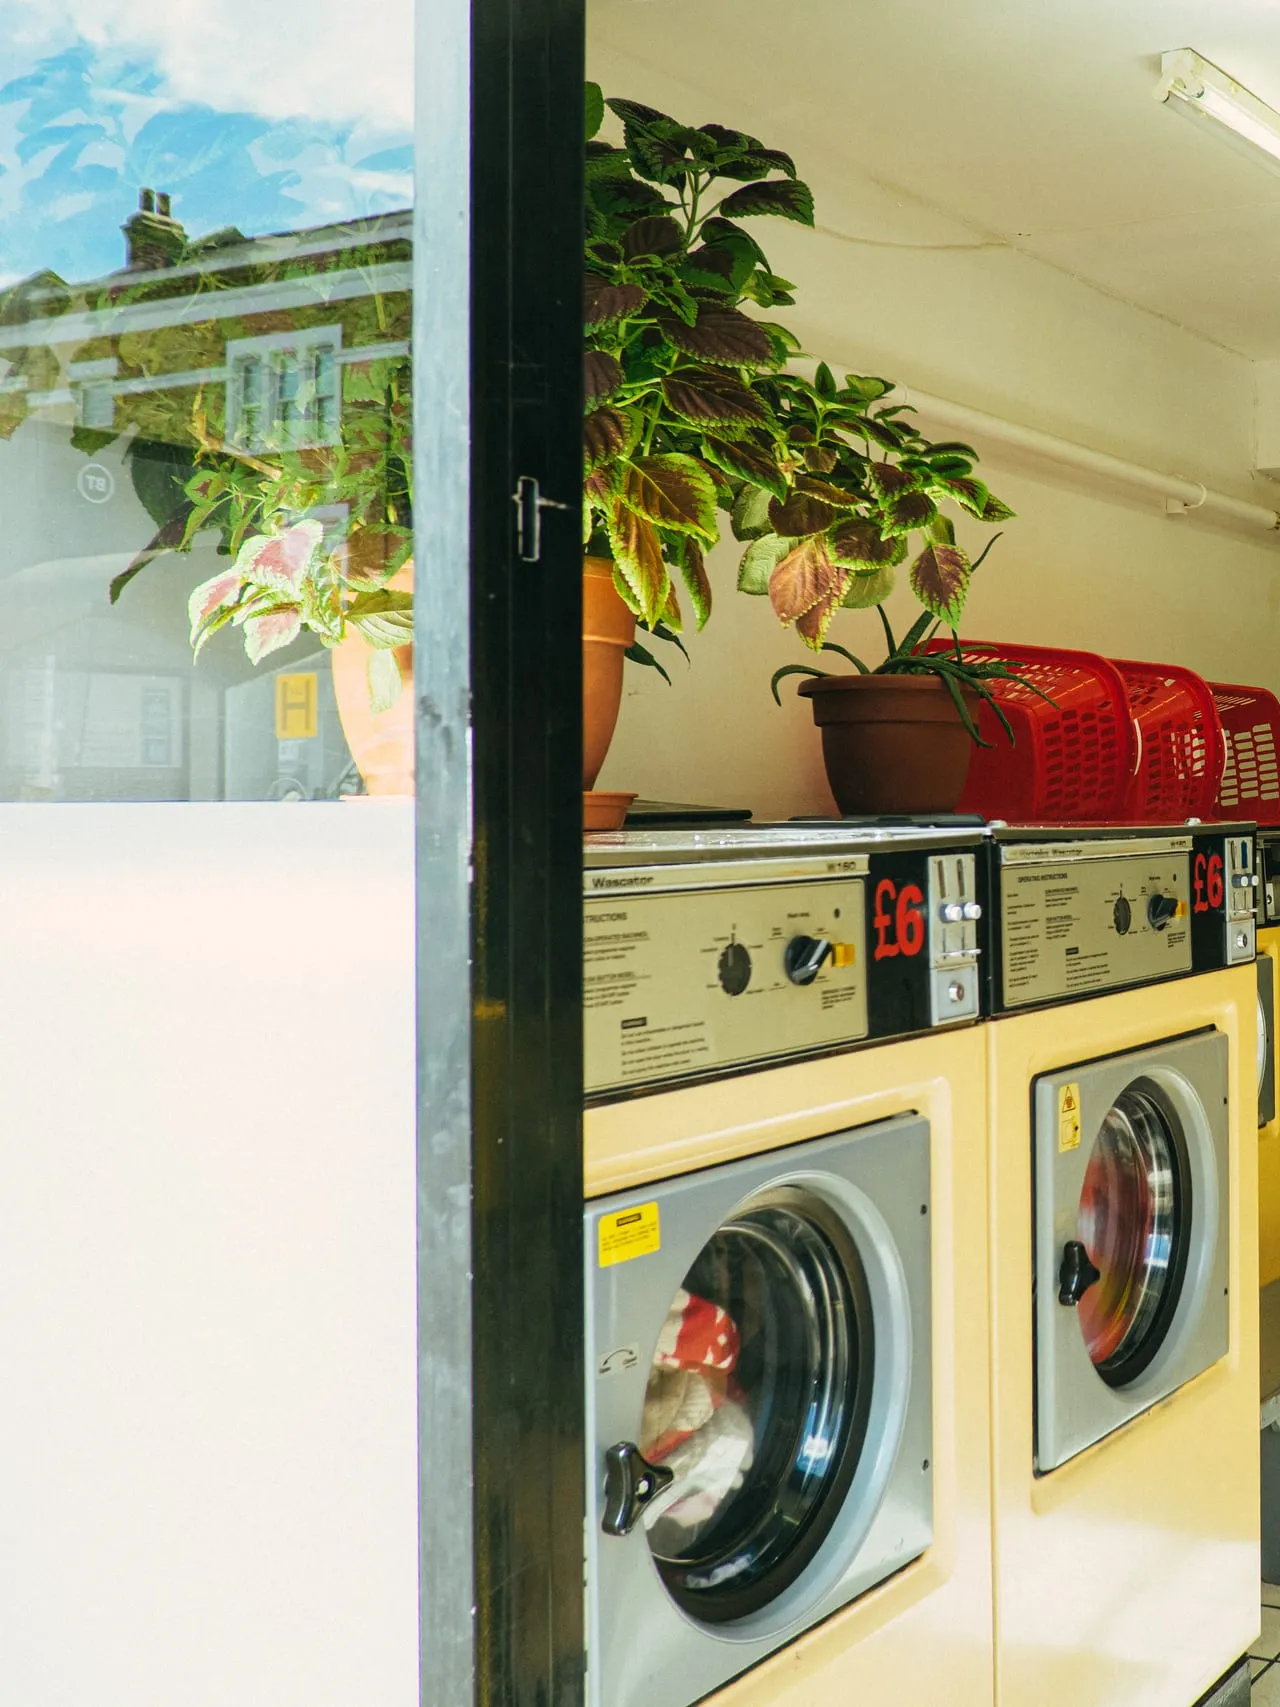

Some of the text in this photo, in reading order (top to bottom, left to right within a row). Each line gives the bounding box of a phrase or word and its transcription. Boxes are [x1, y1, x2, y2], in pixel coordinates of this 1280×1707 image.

[592, 877, 654, 889] Wascator
[1193, 852, 1223, 913] £6
[874, 878, 924, 961] £6
